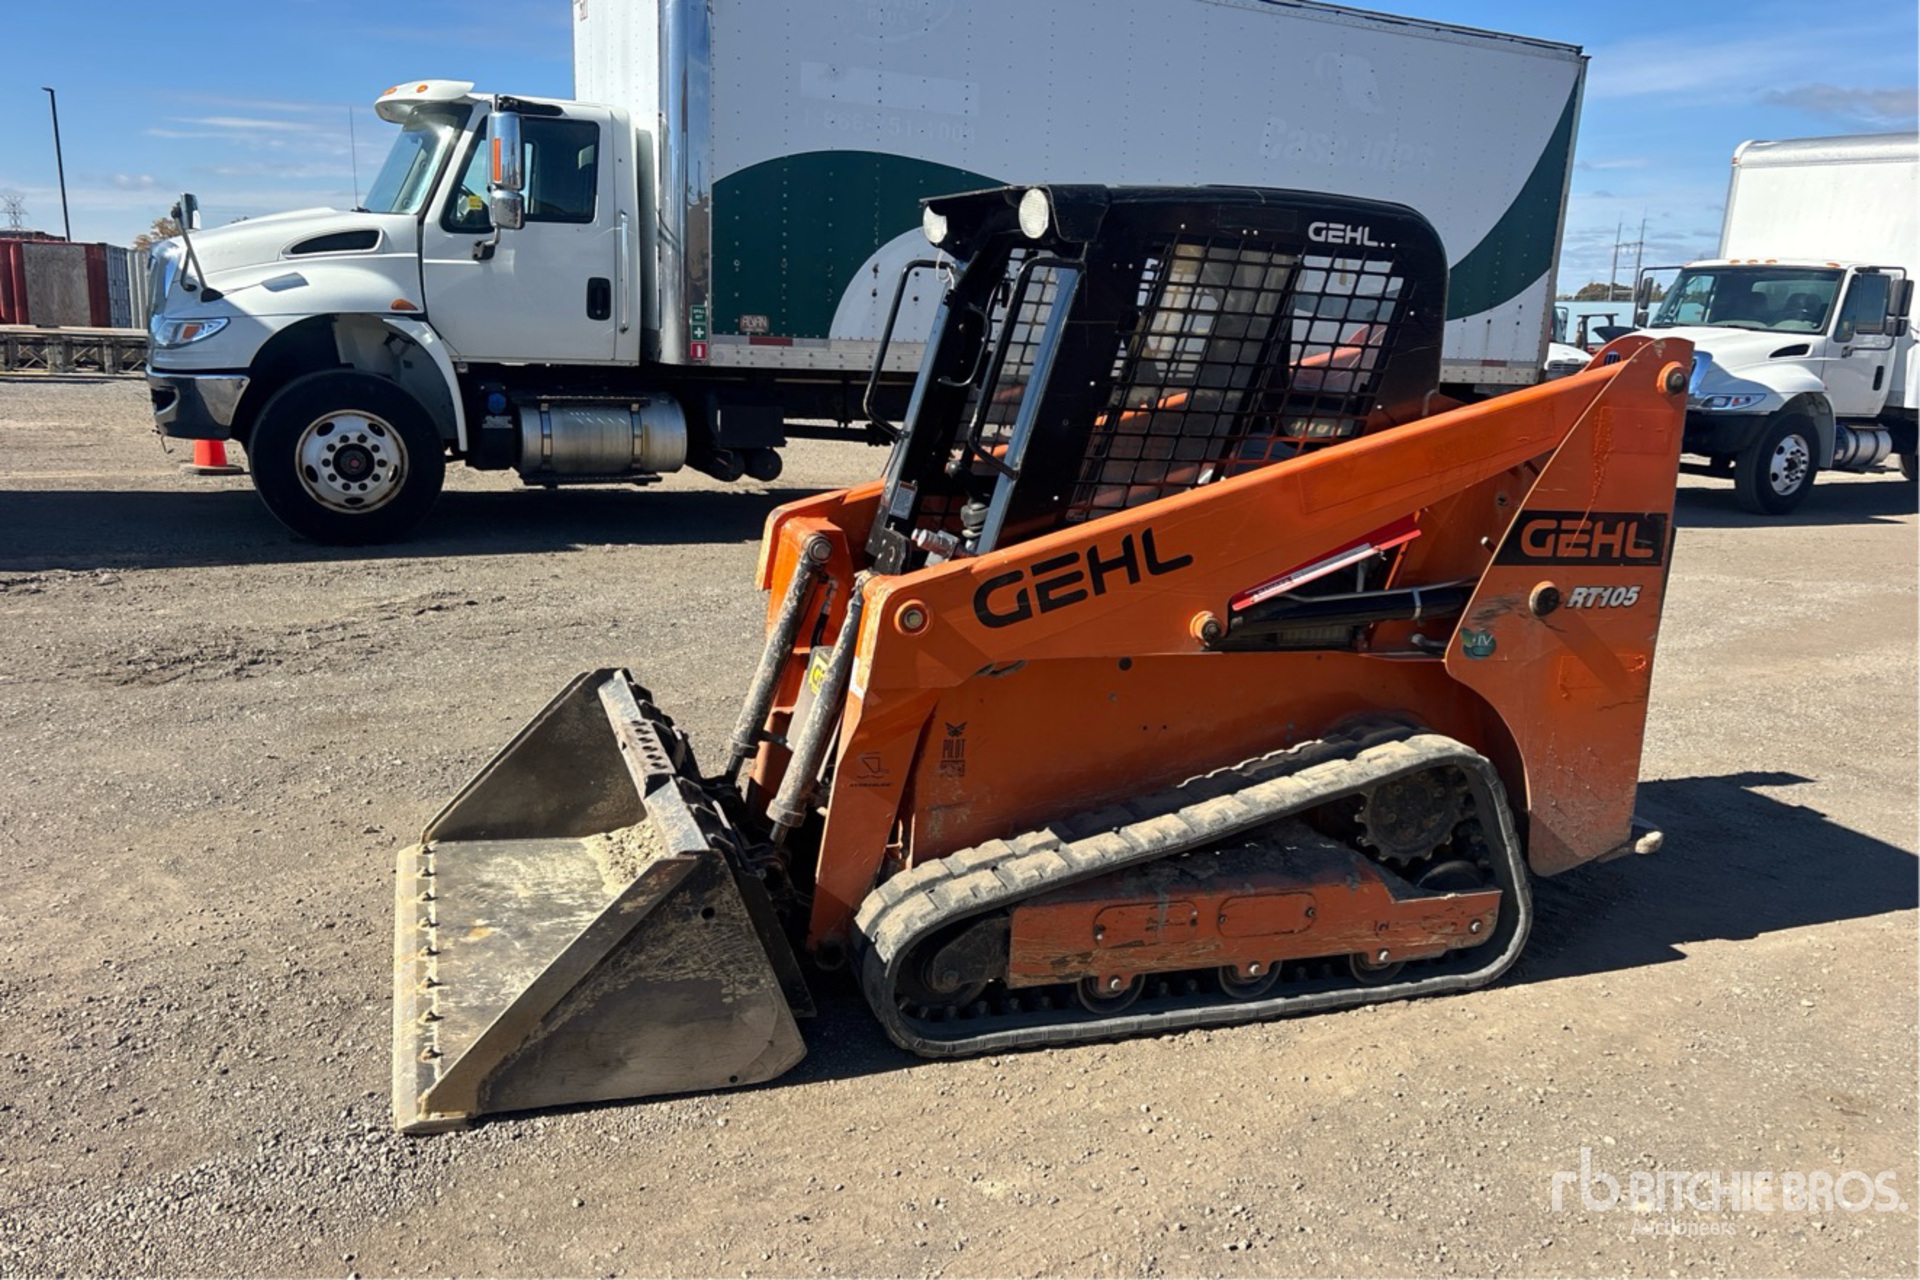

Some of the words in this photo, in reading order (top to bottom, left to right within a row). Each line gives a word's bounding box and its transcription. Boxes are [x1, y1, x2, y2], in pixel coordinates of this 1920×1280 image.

[1308, 221, 1379, 247] GEHL
[1521, 519, 1654, 558] GEHL
[973, 527, 1193, 628] GEHL
[1567, 586, 1642, 608] RT105
